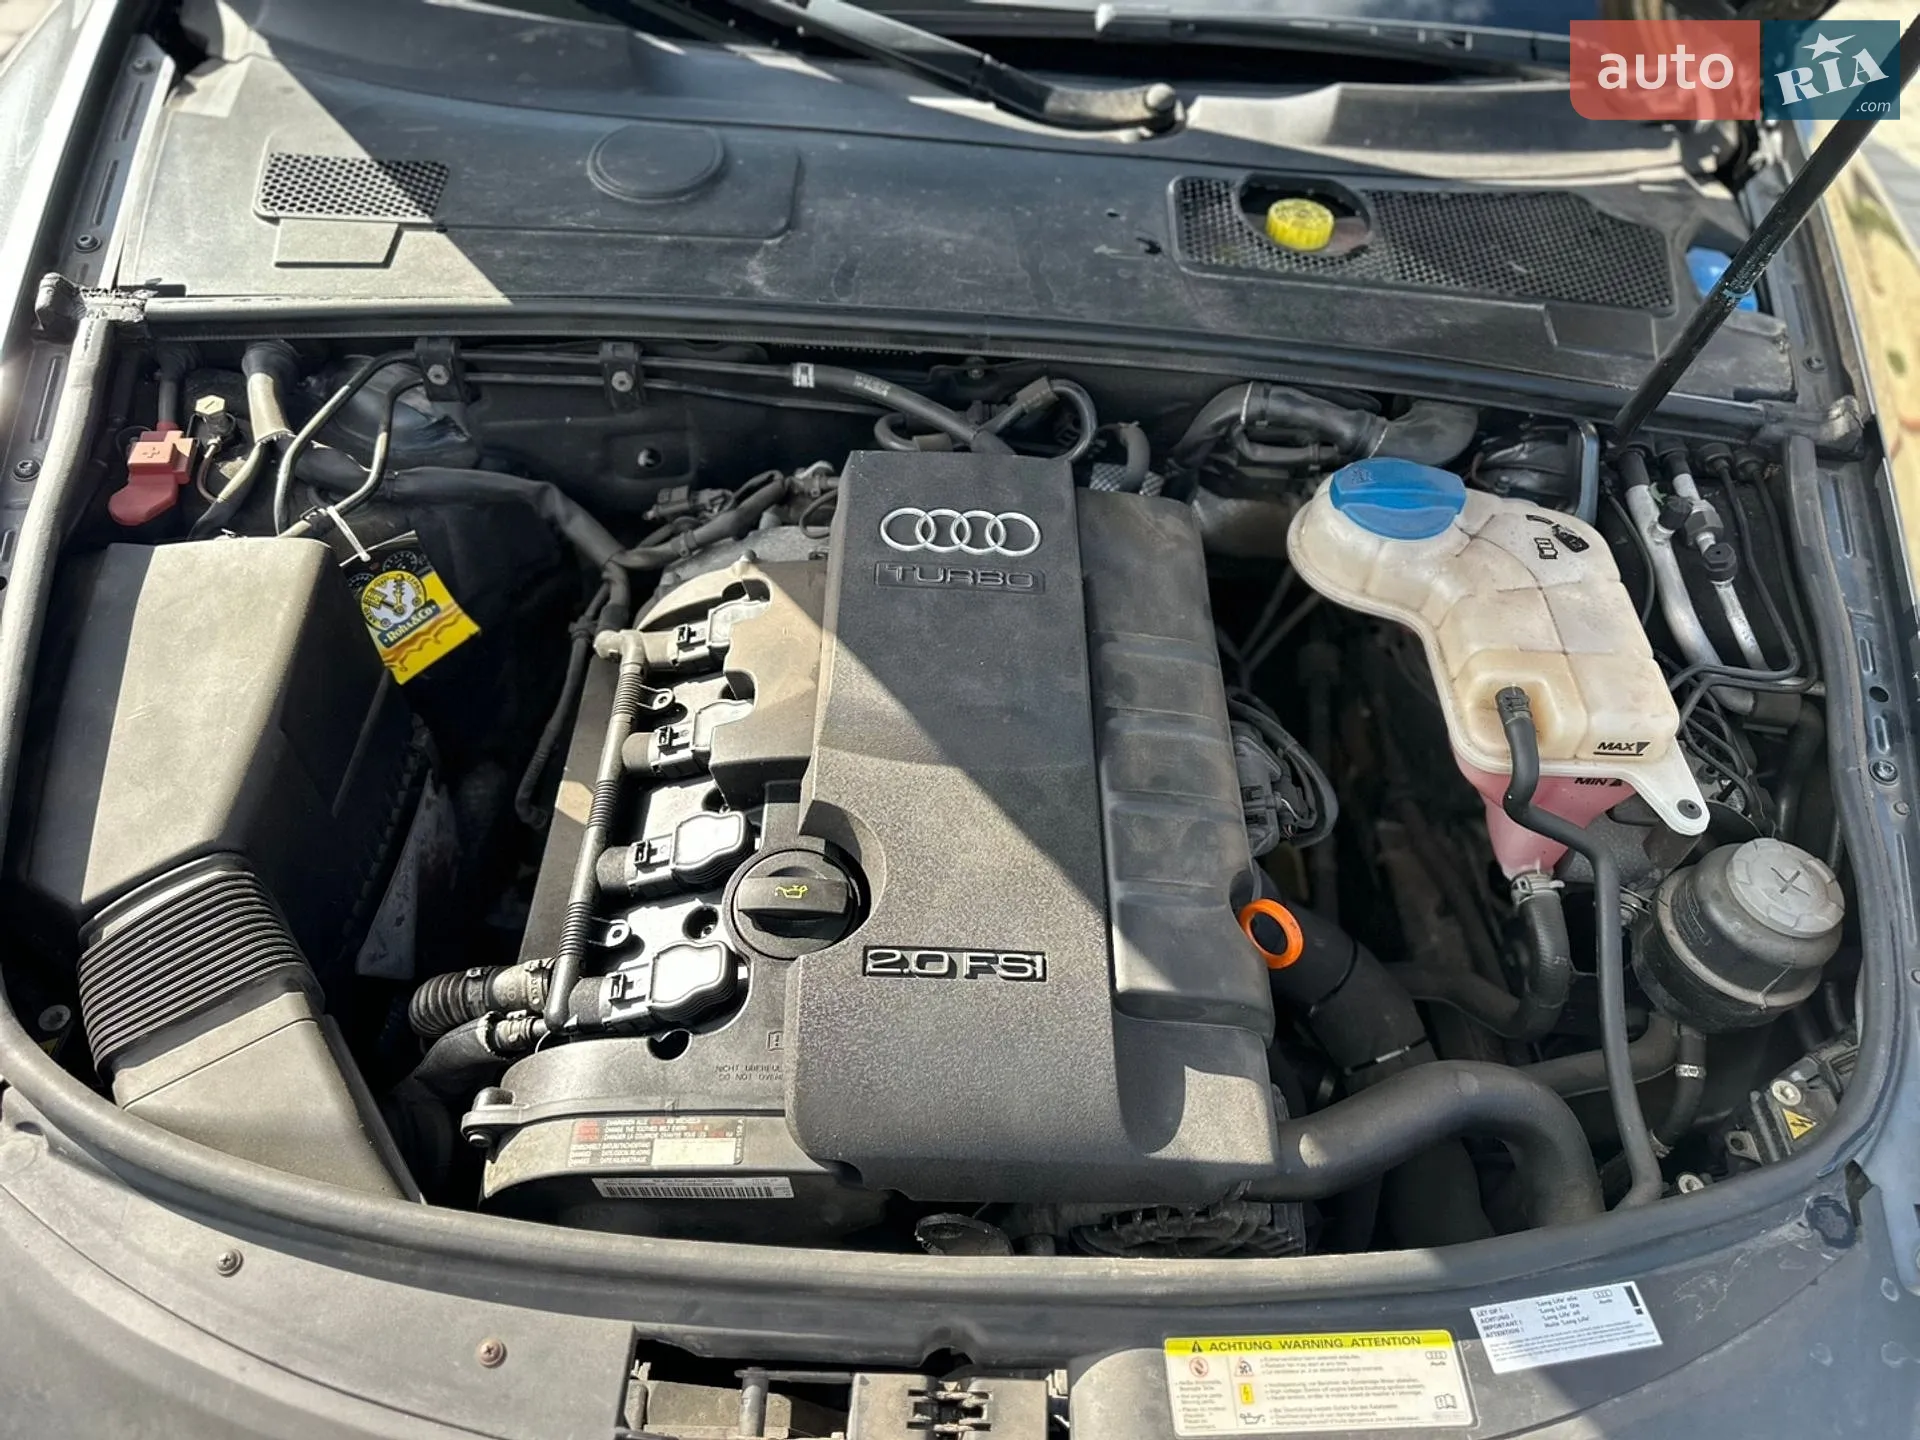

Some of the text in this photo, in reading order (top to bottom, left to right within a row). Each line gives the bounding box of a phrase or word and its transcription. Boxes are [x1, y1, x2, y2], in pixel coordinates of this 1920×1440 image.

[885, 564, 1034, 588] TURBO
[1597, 741, 1636, 751] MAX
[1574, 777, 1608, 786] MIN
[866, 949, 1044, 980] 2.0 FSI
[1209, 1336, 1422, 1352] ACHTUNG WARNING ATTENTION
